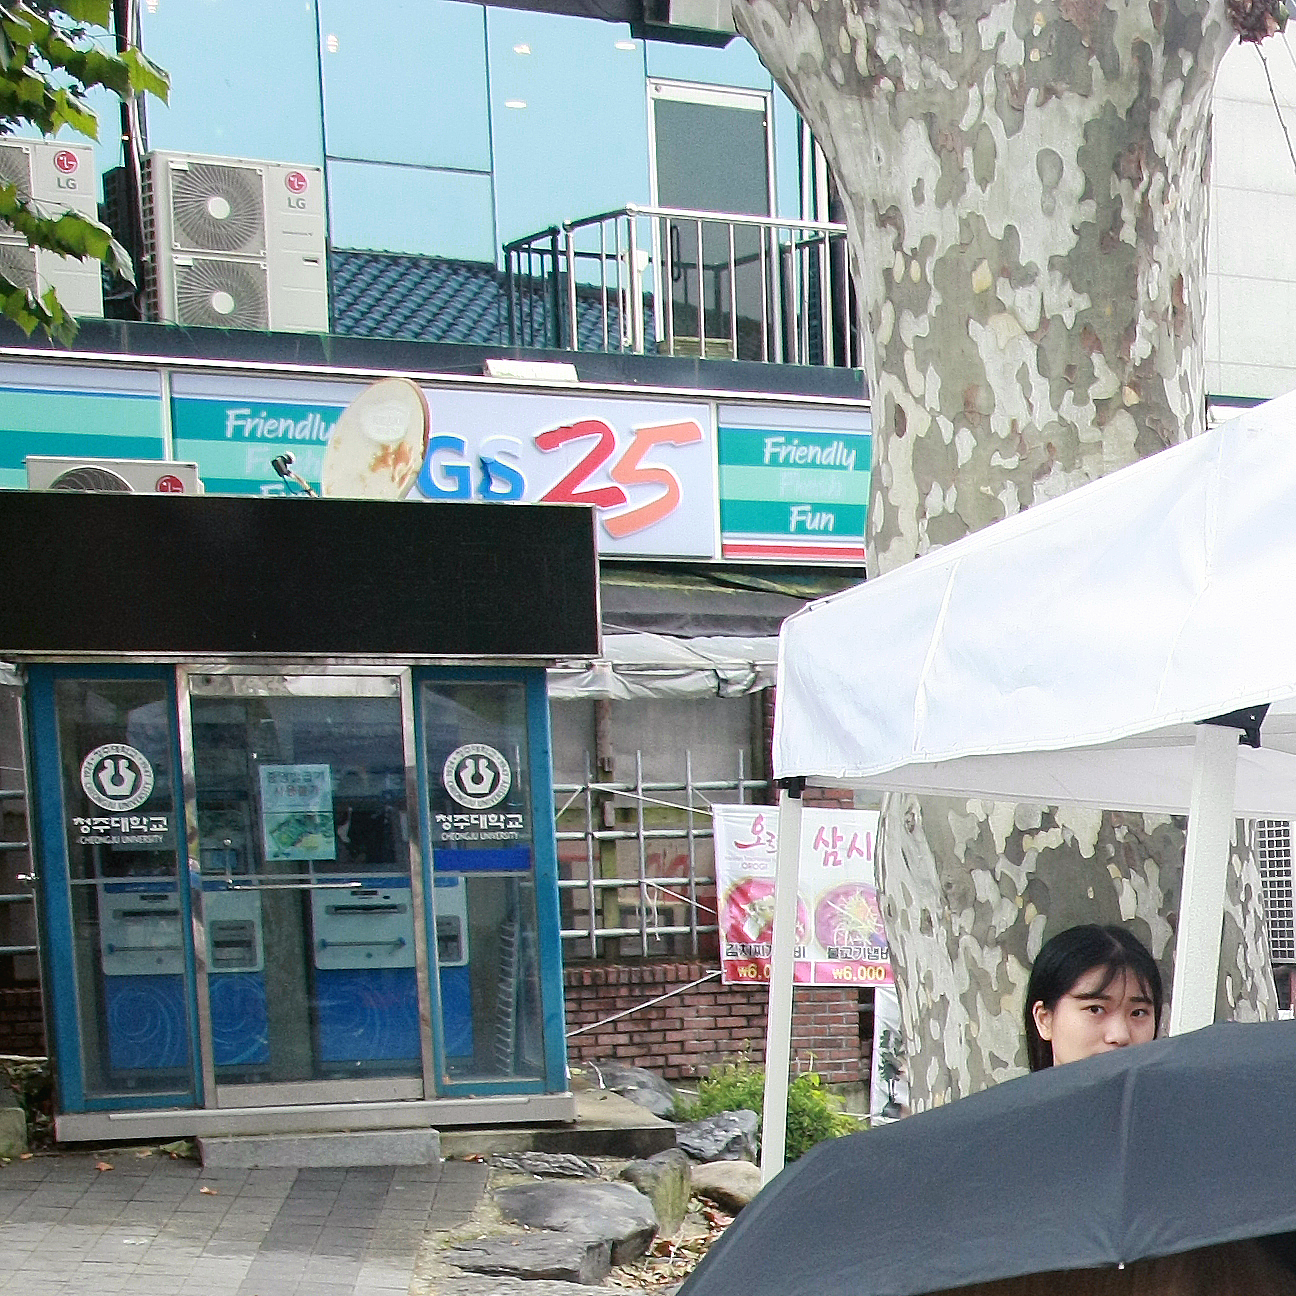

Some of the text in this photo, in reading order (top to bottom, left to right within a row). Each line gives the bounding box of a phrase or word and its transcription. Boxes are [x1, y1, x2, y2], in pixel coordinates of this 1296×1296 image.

[57, 177, 77, 190] LG
[287, 197, 306, 210] LG
[762, 436, 858, 472] Friendly
[788, 504, 836, 532] Fun
[72, 816, 169, 834] 청주대학교
[435, 813, 523, 830] 청주대학교
[122, 835, 163, 844] UNIVERSITY
[480, 832, 518, 840] UNIVERSITY
